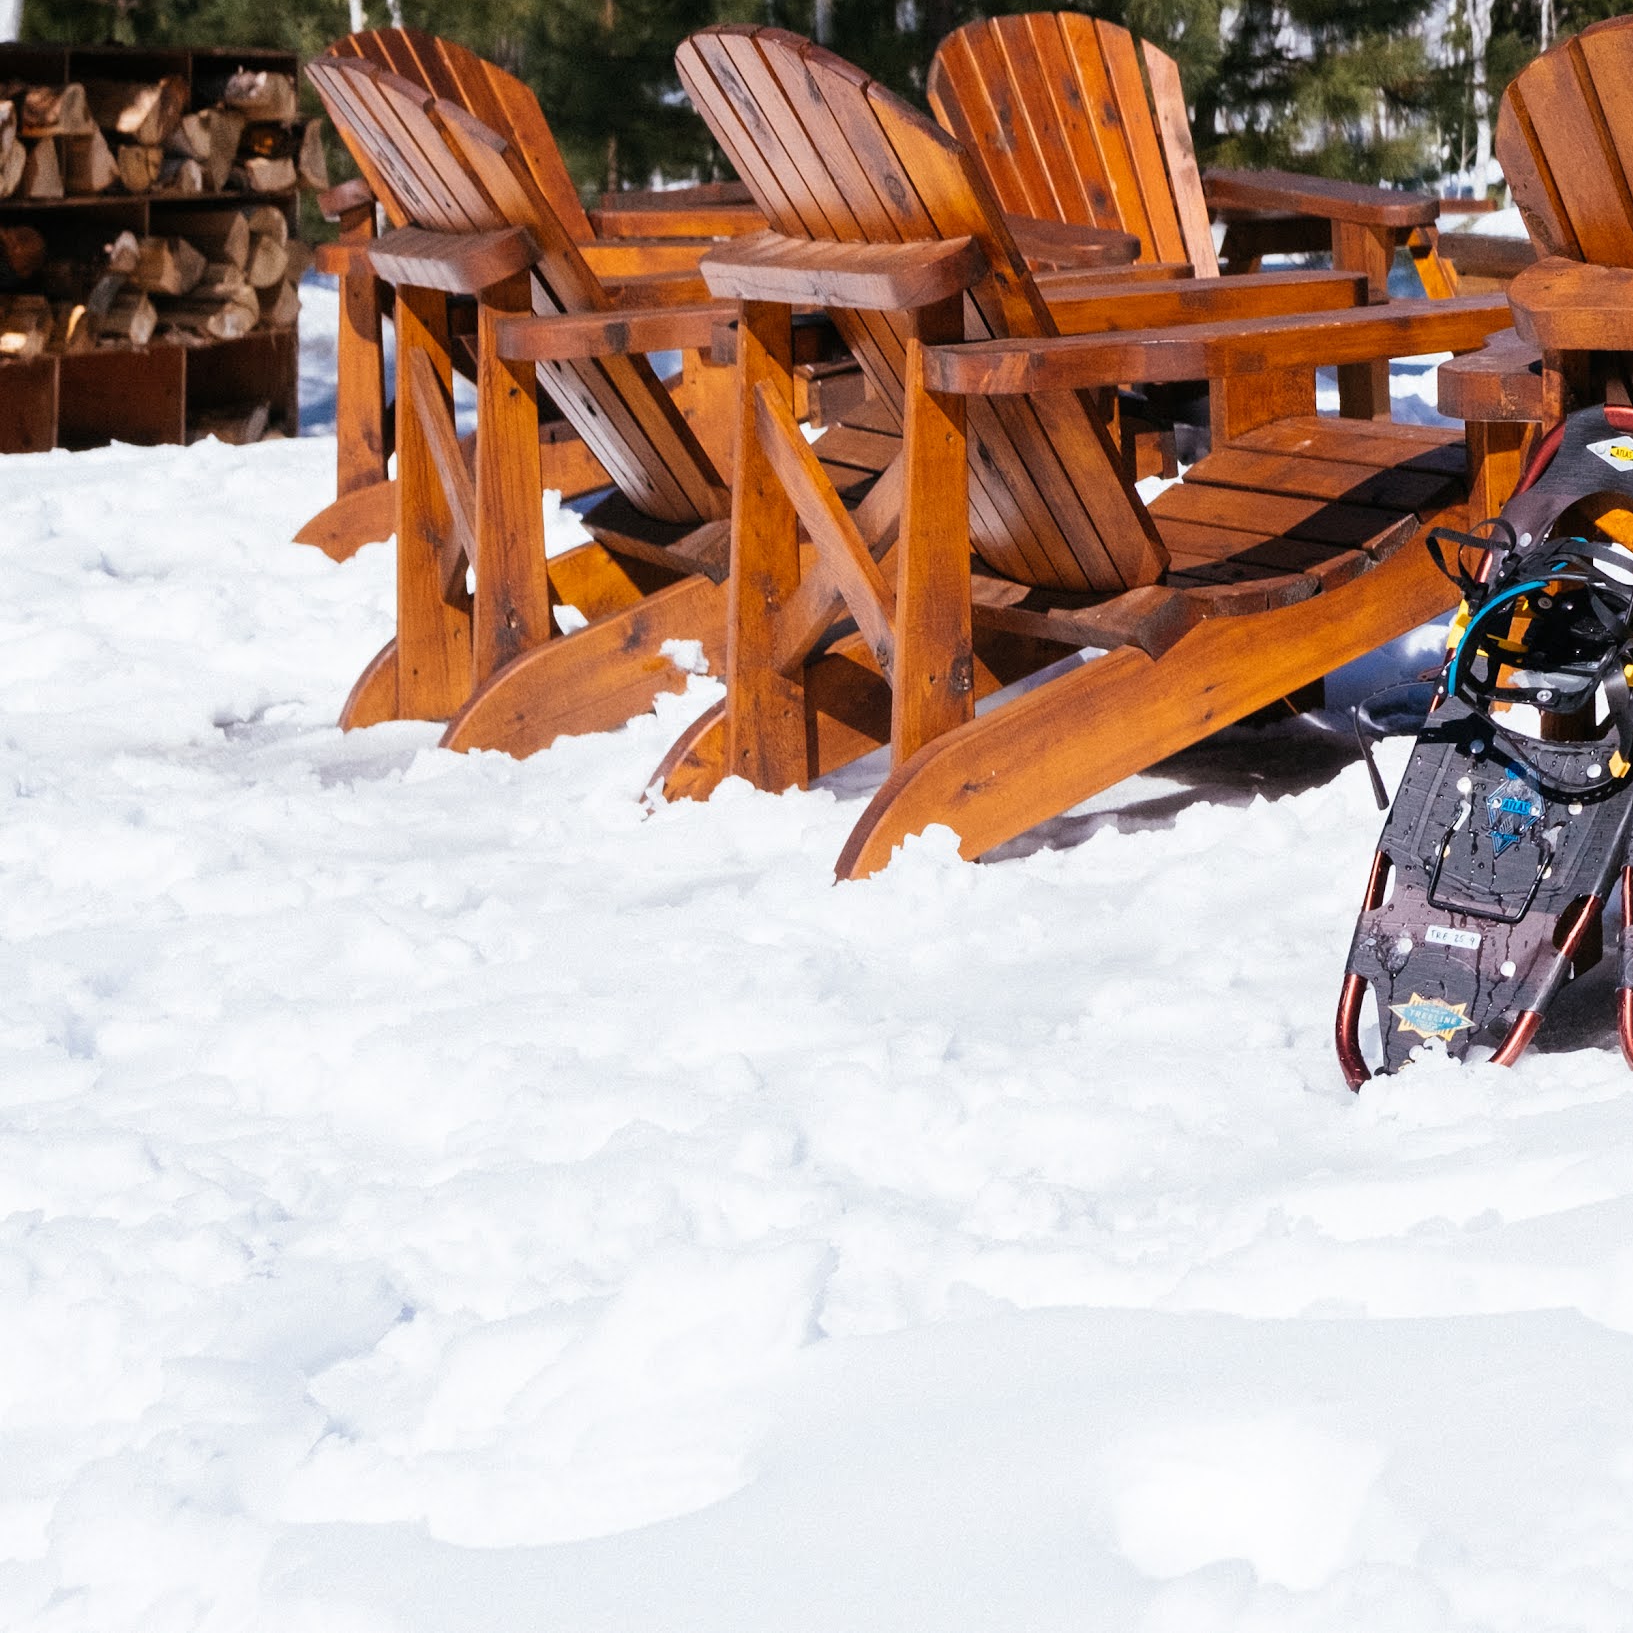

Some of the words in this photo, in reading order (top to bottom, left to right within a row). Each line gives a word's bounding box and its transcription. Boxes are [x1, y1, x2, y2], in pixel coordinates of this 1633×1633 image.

[1615, 448, 1632, 459] ATLAS
[1503, 800, 1530, 813] ATLAS
[1410, 1009, 1457, 1026] TREELINE
